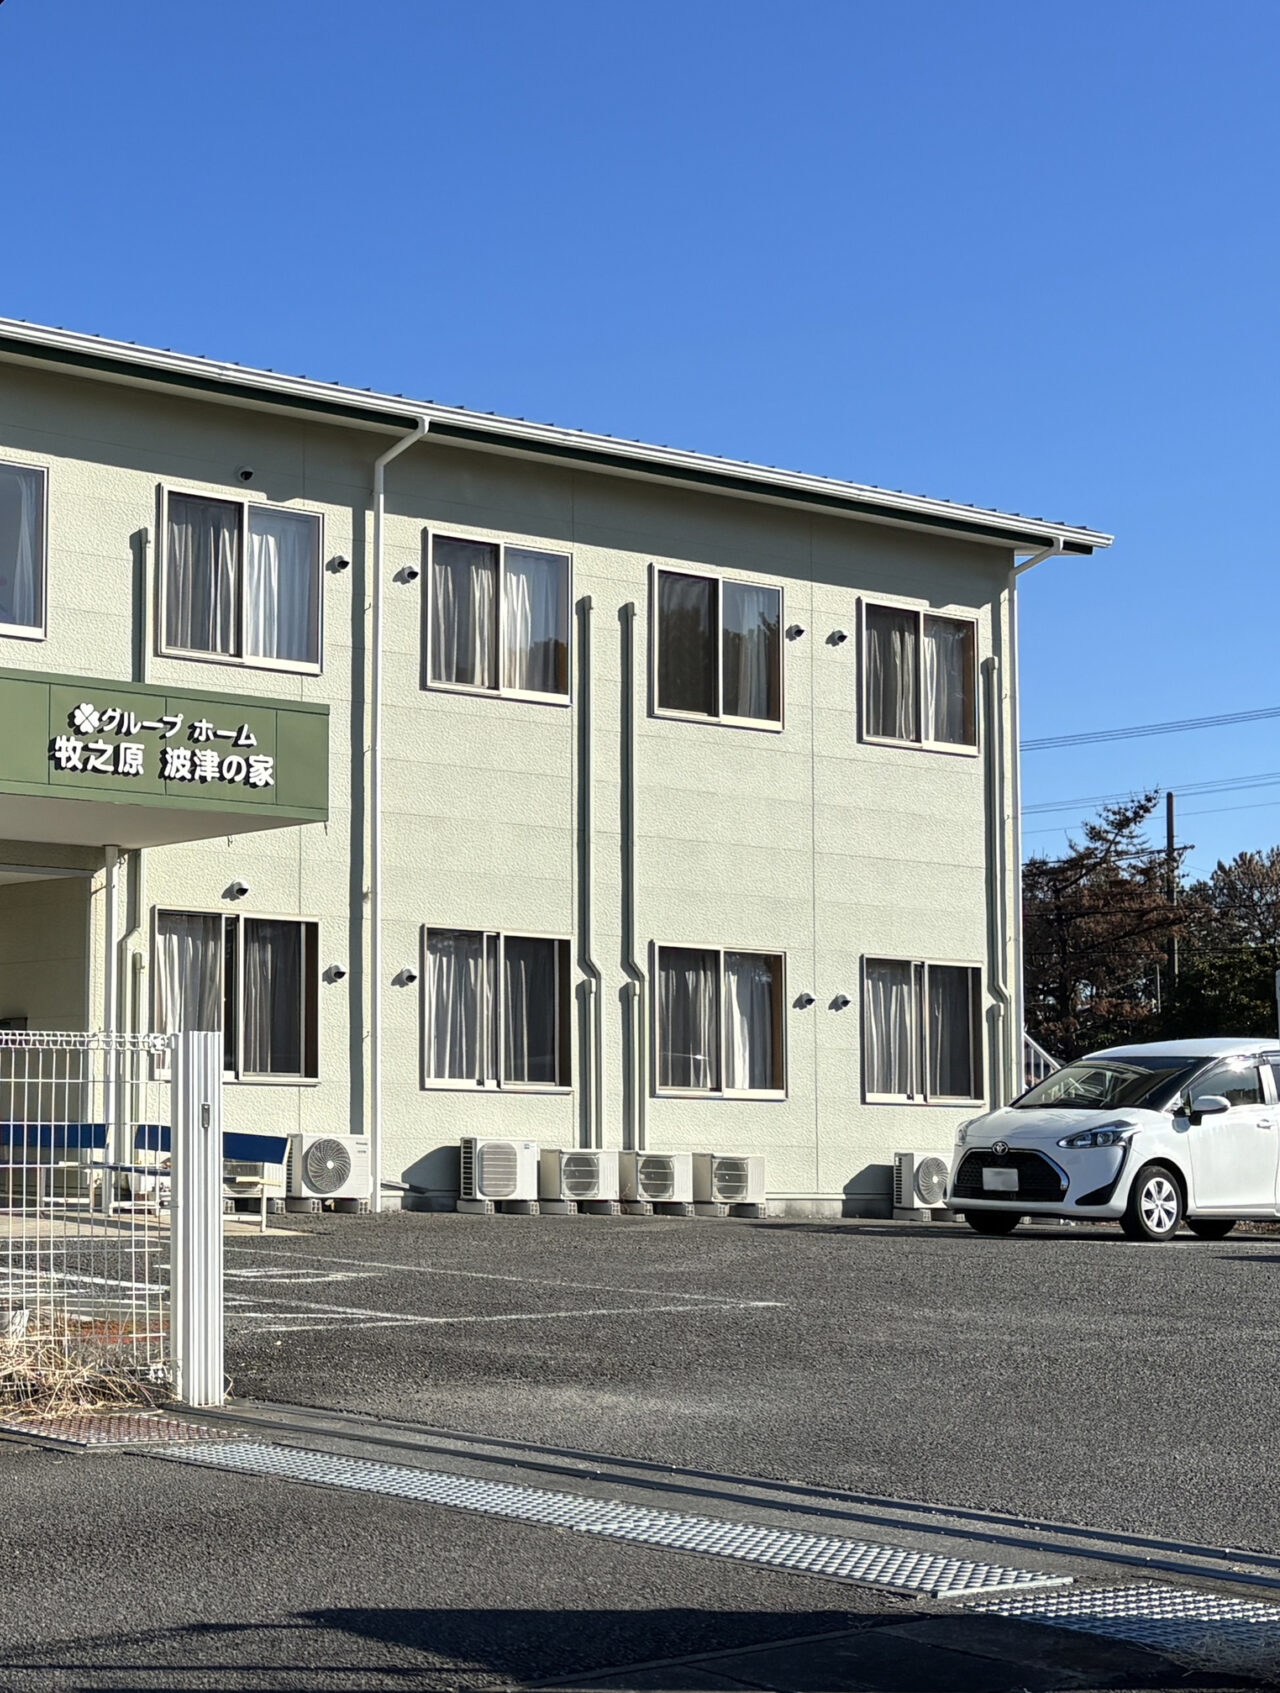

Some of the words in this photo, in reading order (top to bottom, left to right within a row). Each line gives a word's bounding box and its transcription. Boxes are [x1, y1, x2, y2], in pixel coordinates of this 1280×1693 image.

[101, 707, 184, 738] グループ
[193, 718, 258, 746] ホーム
[54, 735, 145, 775] 牧之原
[164, 747, 275, 786] 波津の家
